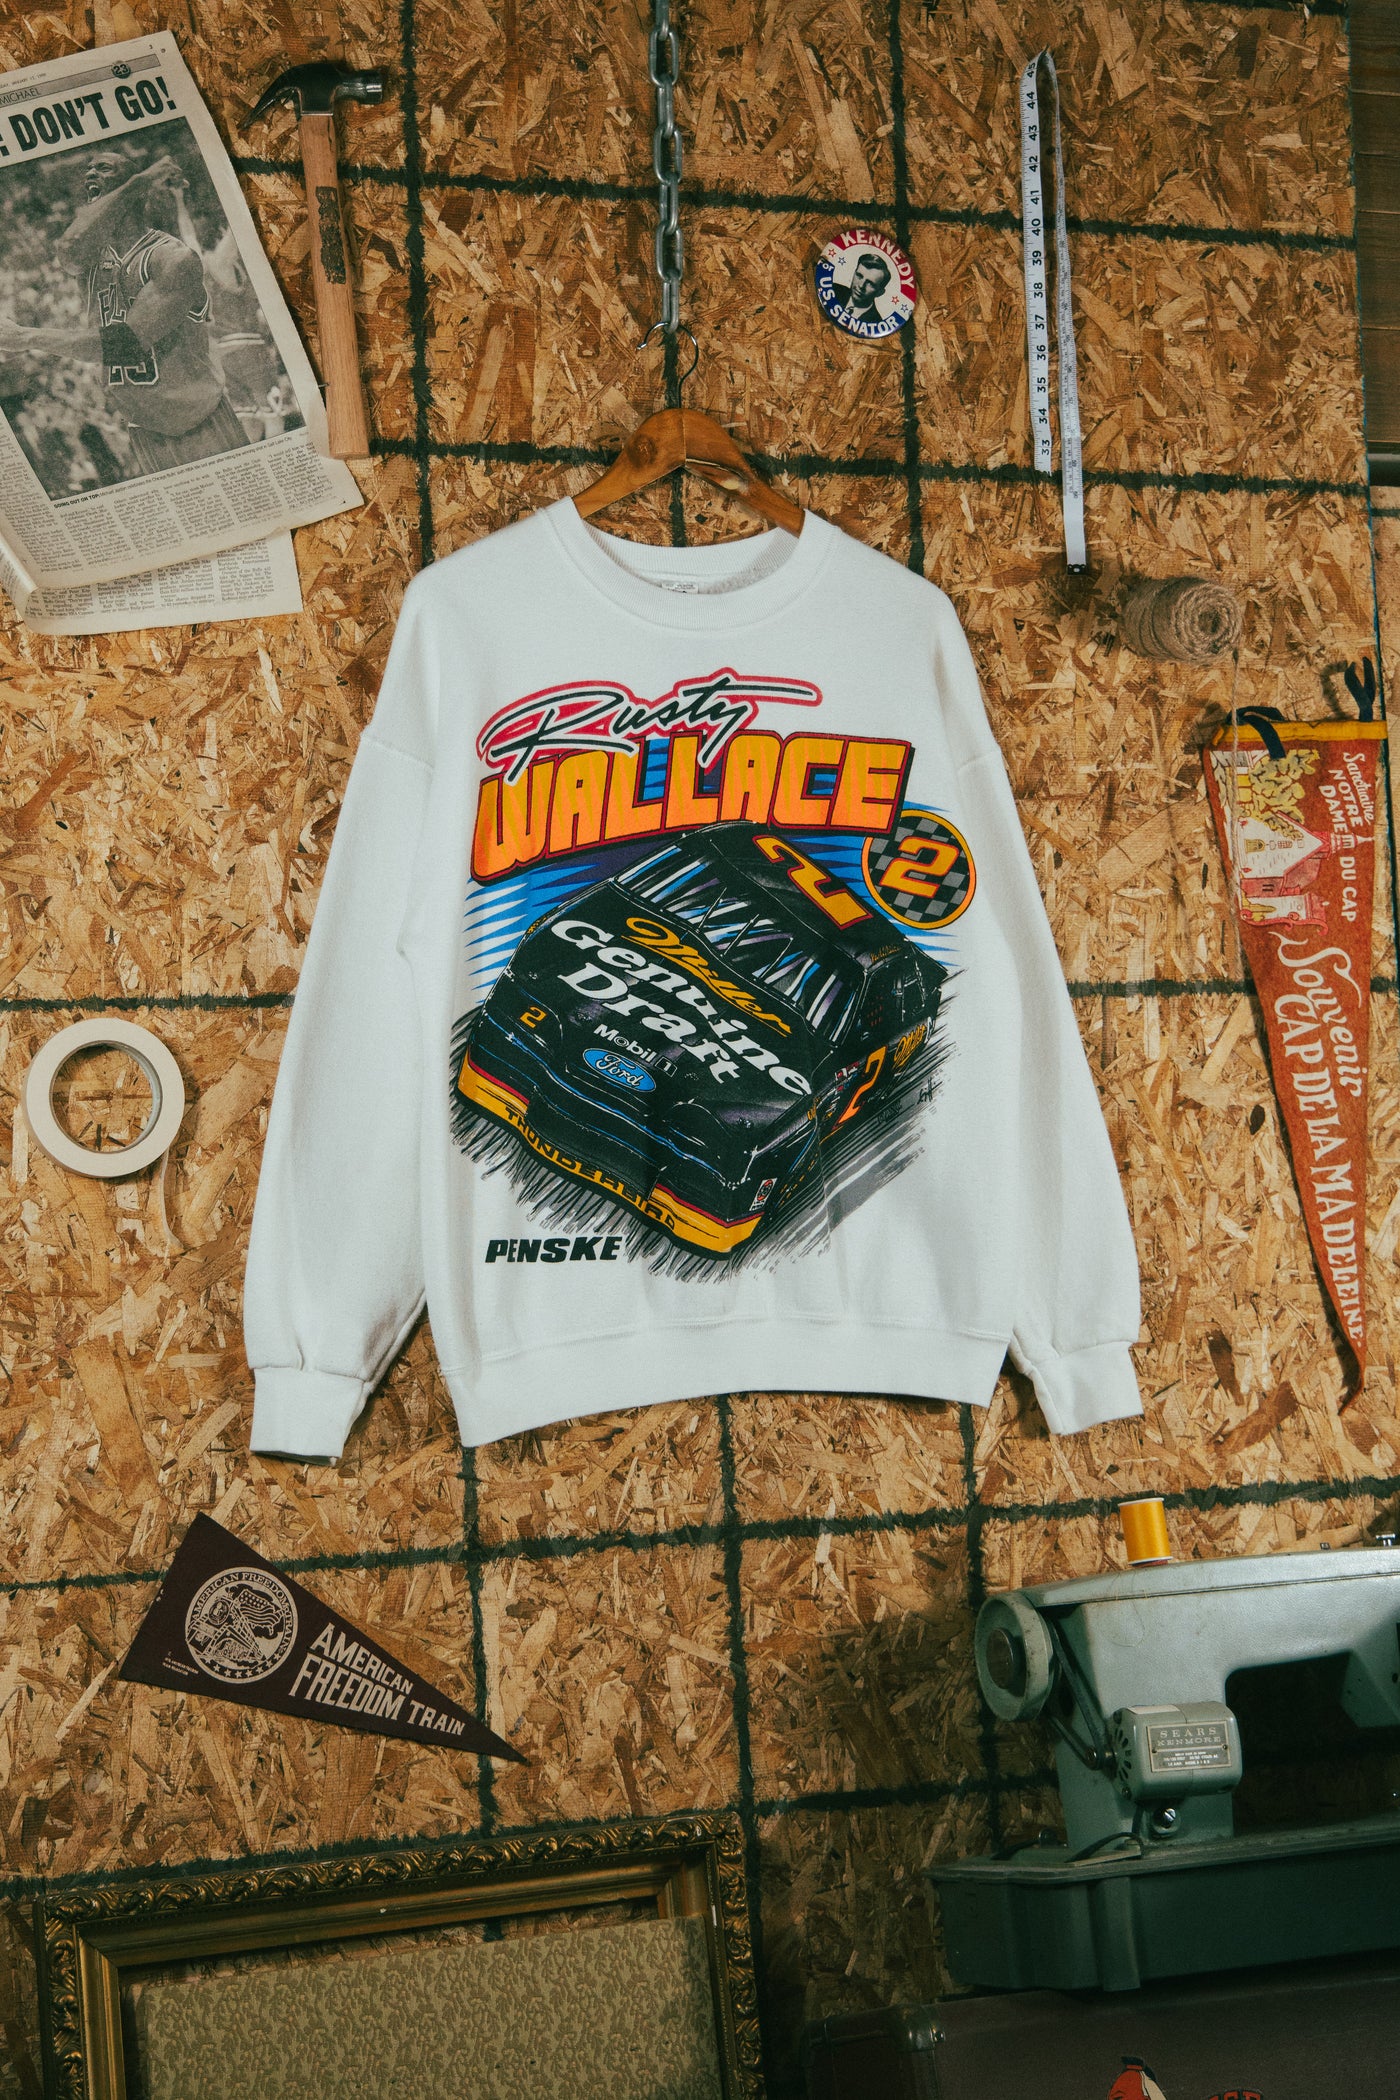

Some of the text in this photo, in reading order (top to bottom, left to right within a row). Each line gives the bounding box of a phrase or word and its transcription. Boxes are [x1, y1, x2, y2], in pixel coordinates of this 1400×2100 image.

[113, 63, 128, 75] 23
[8, 92, 110, 151] DON'T
[114, 76, 177, 122] GO!
[840, 229, 915, 289] KENNEDY
[1026, 62, 1051, 456] 33 34 35 36 37 38 39 40 41 42 43 44 45
[829, 304, 900, 336] SENATOR
[53, 500, 69, 508] GOING
[480, 672, 818, 785] Rusty
[471, 731, 912, 882] WALLACE
[1319, 785, 1349, 833] DAME
[1328, 769, 1363, 827] NOTRE
[1342, 751, 1376, 826] Sanctuaire
[752, 834, 873, 930] 2
[879, 836, 960, 899] 2
[1339, 856, 1357, 923] DU CAP
[551, 919, 812, 1096] Genuine
[621, 917, 793, 1037] Miller
[519, 1006, 548, 1029] 2
[557, 962, 741, 1084] Draft
[594, 1024, 657, 1063] Mobil
[1268, 931, 1369, 1098] Souvenir
[1274, 993, 1324, 1065] CAP
[596, 1053, 645, 1087] Ford
[1291, 1067, 1338, 1113] DE
[505, 1105, 676, 1231] THUNDERBIRD
[1304, 1112, 1349, 1162] LA
[485, 1236, 623, 1264] PENSKE
[191, 1572, 239, 1619] AMERICAN
[241, 1572, 289, 1610] FREEDOM
[308, 1623, 414, 1696] AMERICAN
[288, 1651, 467, 1737] FREEDOM TRAIN
[1156, 1736, 1221, 1747] KENMORE
[1160, 1726, 1217, 1739] SEARS
